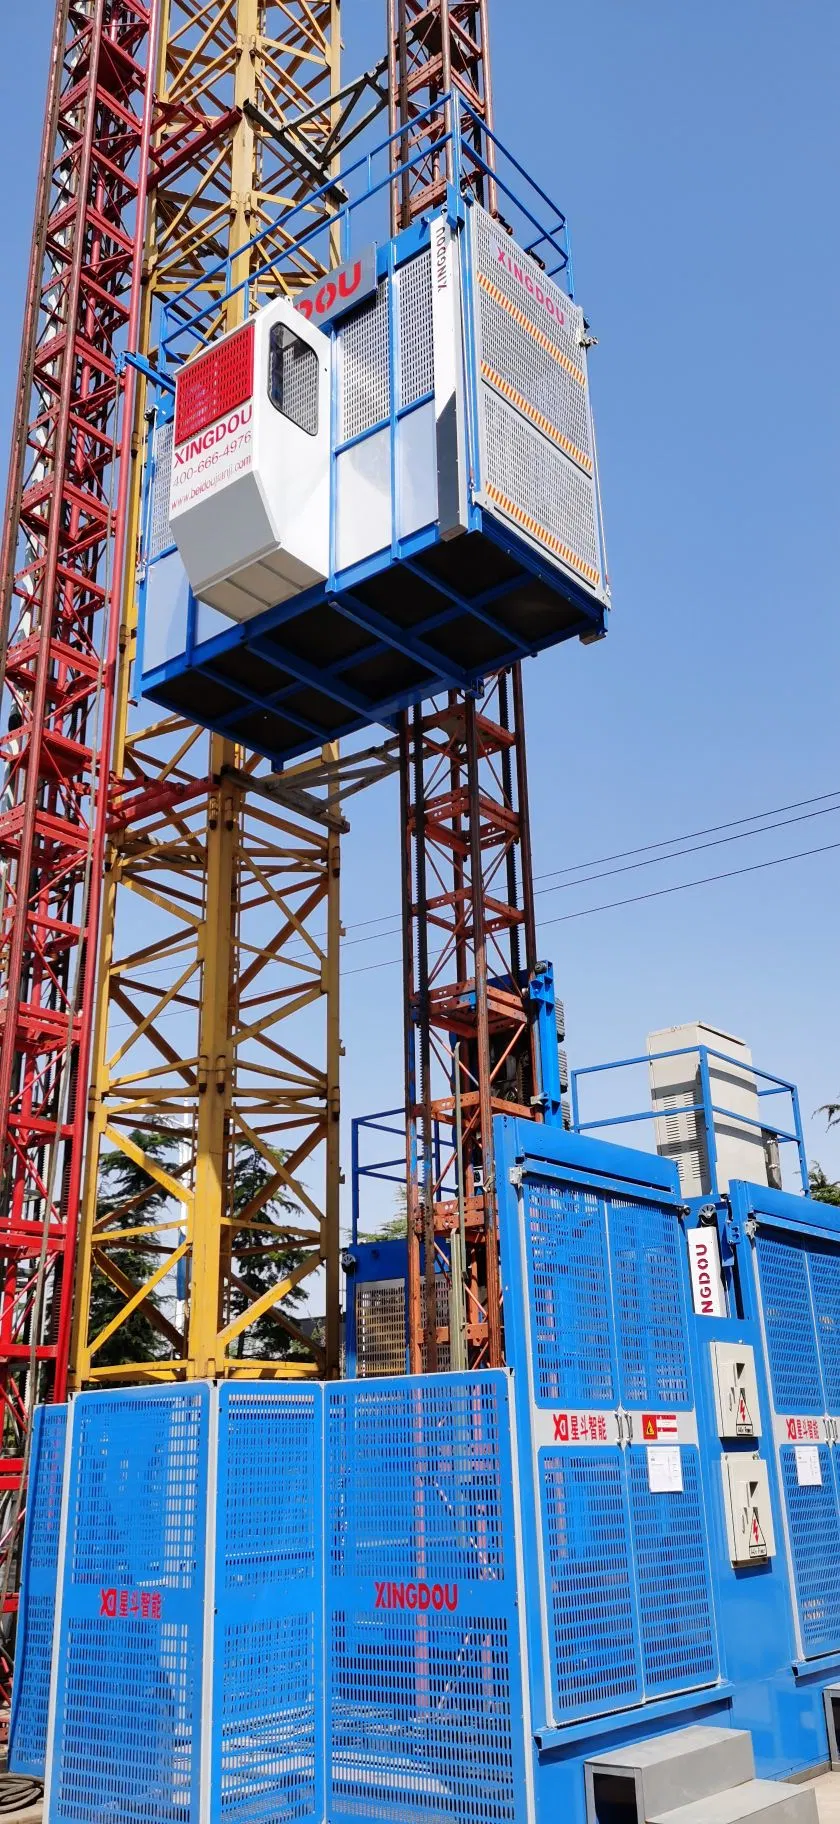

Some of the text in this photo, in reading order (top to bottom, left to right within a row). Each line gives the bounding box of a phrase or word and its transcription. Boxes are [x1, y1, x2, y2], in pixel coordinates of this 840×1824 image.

[435, 226, 447, 293] XINGDOU
[497, 246, 565, 325] XINGDOU
[172, 430, 252, 488] 400-666-4976
[173, 404, 252, 469] XINGDOU
[695, 1243, 714, 1314] NGDOU
[570, 1414, 607, 1441] 星斗智能
[119, 1590, 161, 1619] 星斗智能
[374, 1581, 458, 1611] XINGDOU
